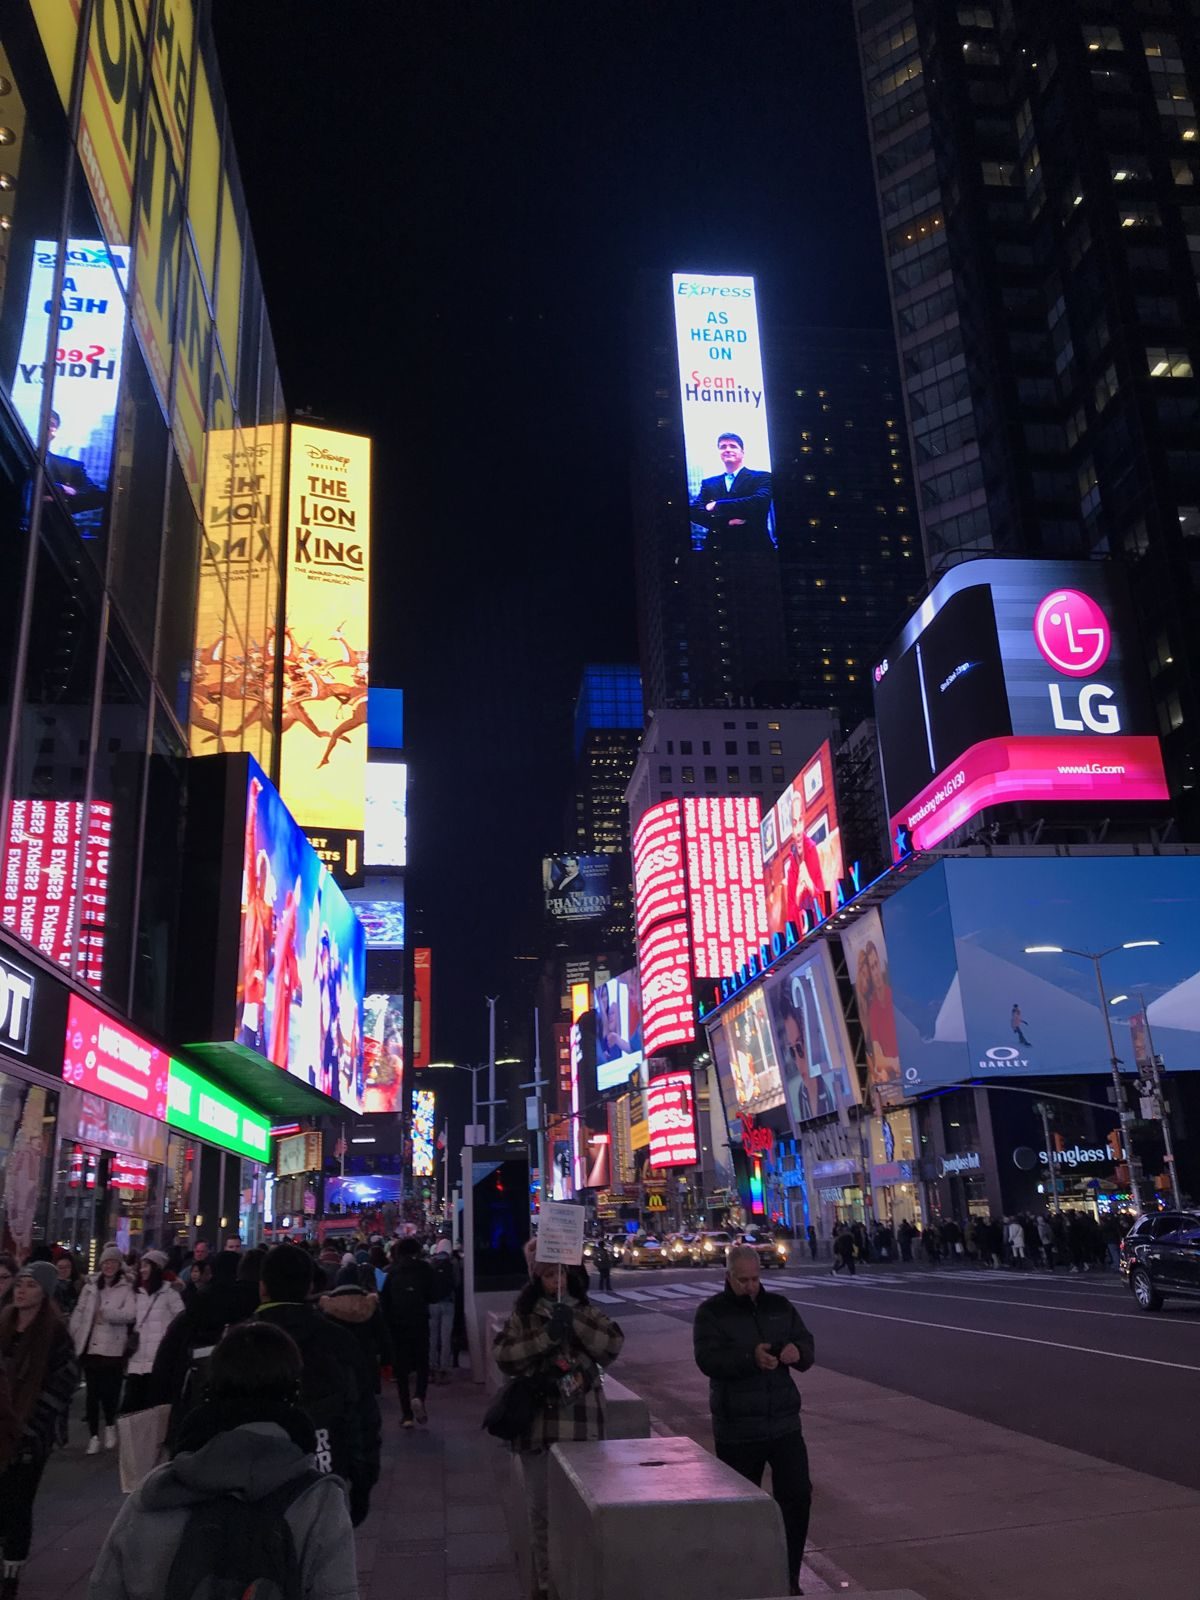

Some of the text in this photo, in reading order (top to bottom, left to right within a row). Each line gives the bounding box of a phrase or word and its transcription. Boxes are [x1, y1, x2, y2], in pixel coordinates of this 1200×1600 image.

[706, 311, 729, 325] AS
[690, 328, 747, 343] HEARD
[709, 347, 732, 361] ON
[691, 370, 735, 389] Sean
[685, 383, 762, 408] Hannity
[307, 475, 347, 498] THE
[300, 495, 356, 527] LION
[295, 527, 364, 565] KING
[1048, 683, 1121, 734] LG
[1057, 764, 1125, 774] www.LG.com
[908, 798, 936, 828] Introducing
[944, 781, 953, 797] LG
[951, 770, 965, 790] V30
[546, 895, 611, 910] PHANTOM
[579, 905, 607, 913] OPERA
[979, 1059, 1029, 1068] OAKLEY
